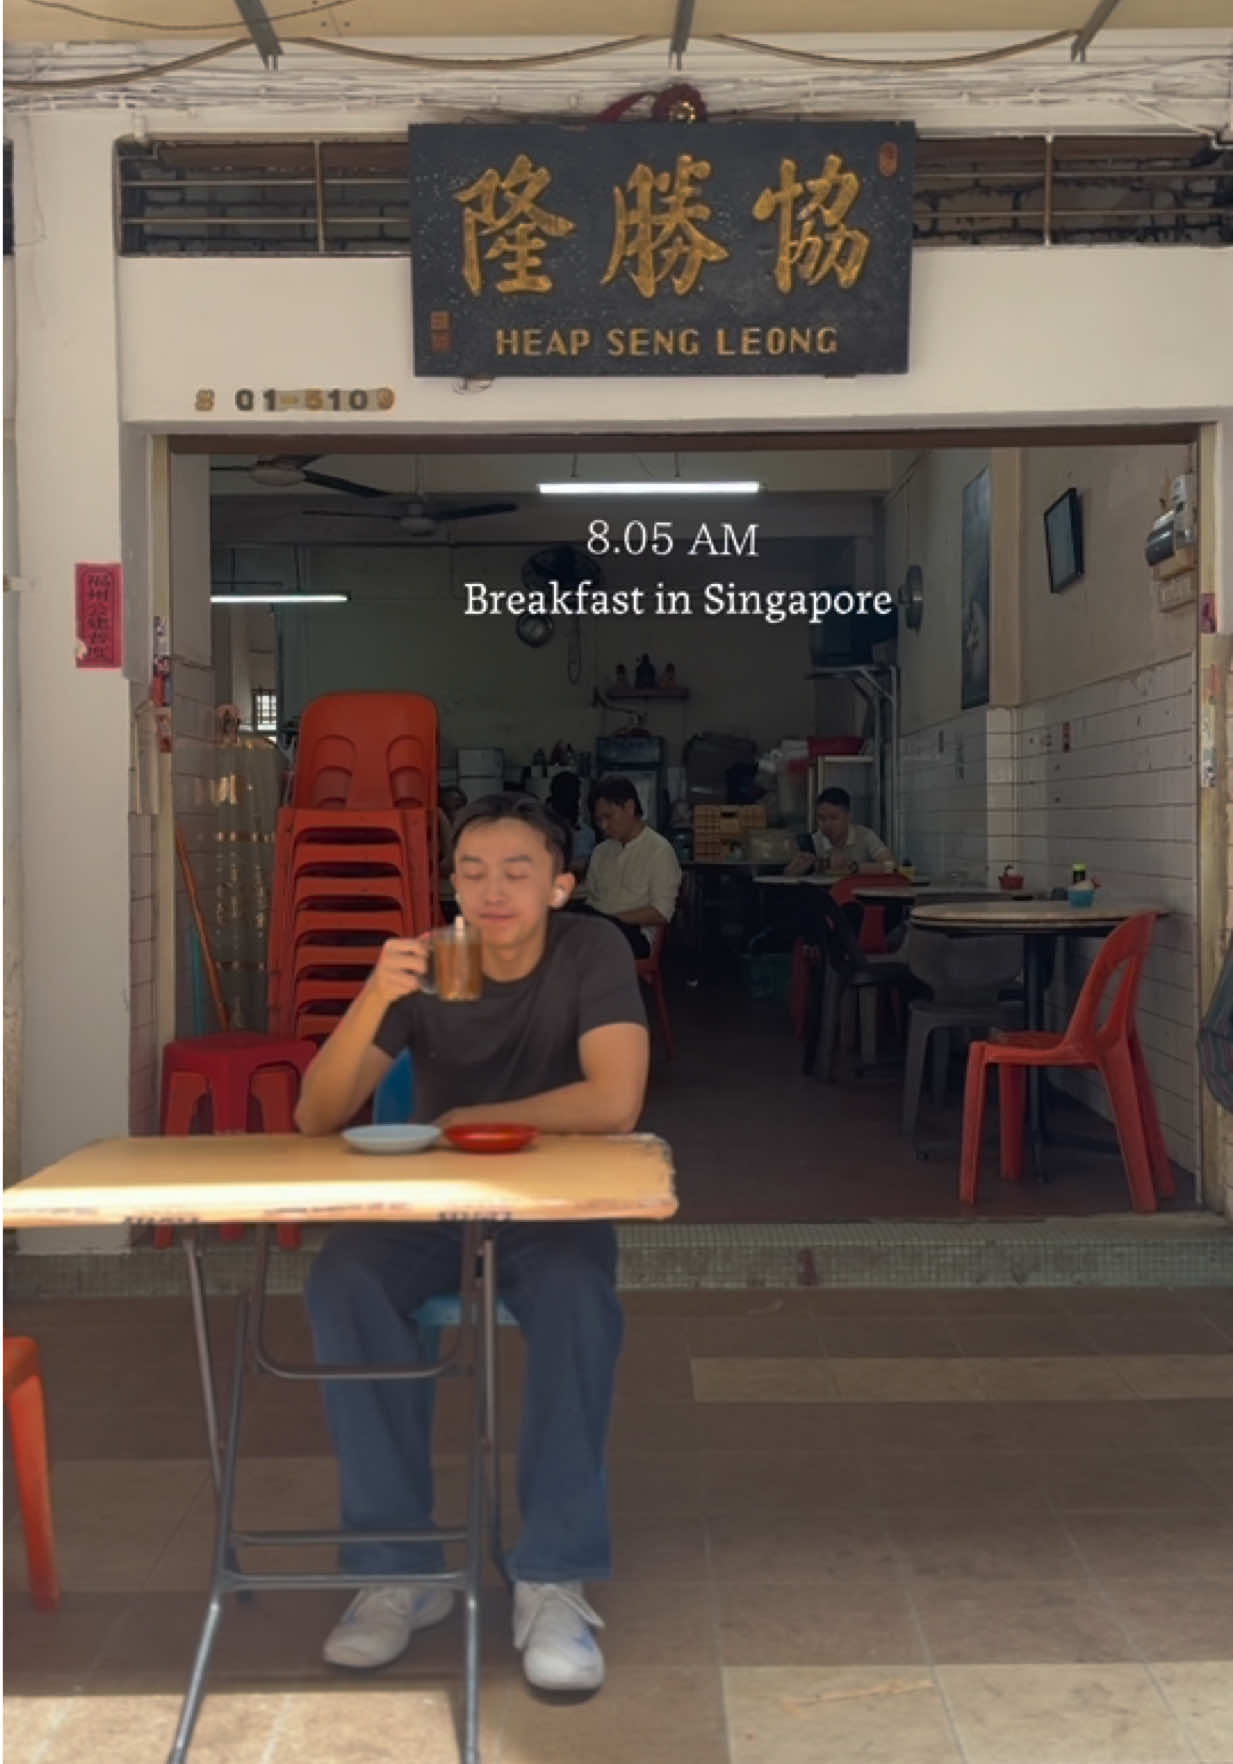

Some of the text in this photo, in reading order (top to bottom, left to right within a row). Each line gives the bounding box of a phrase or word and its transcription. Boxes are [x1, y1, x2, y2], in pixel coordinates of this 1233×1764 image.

[496, 327, 839, 358] HEAP SENG LEONG
